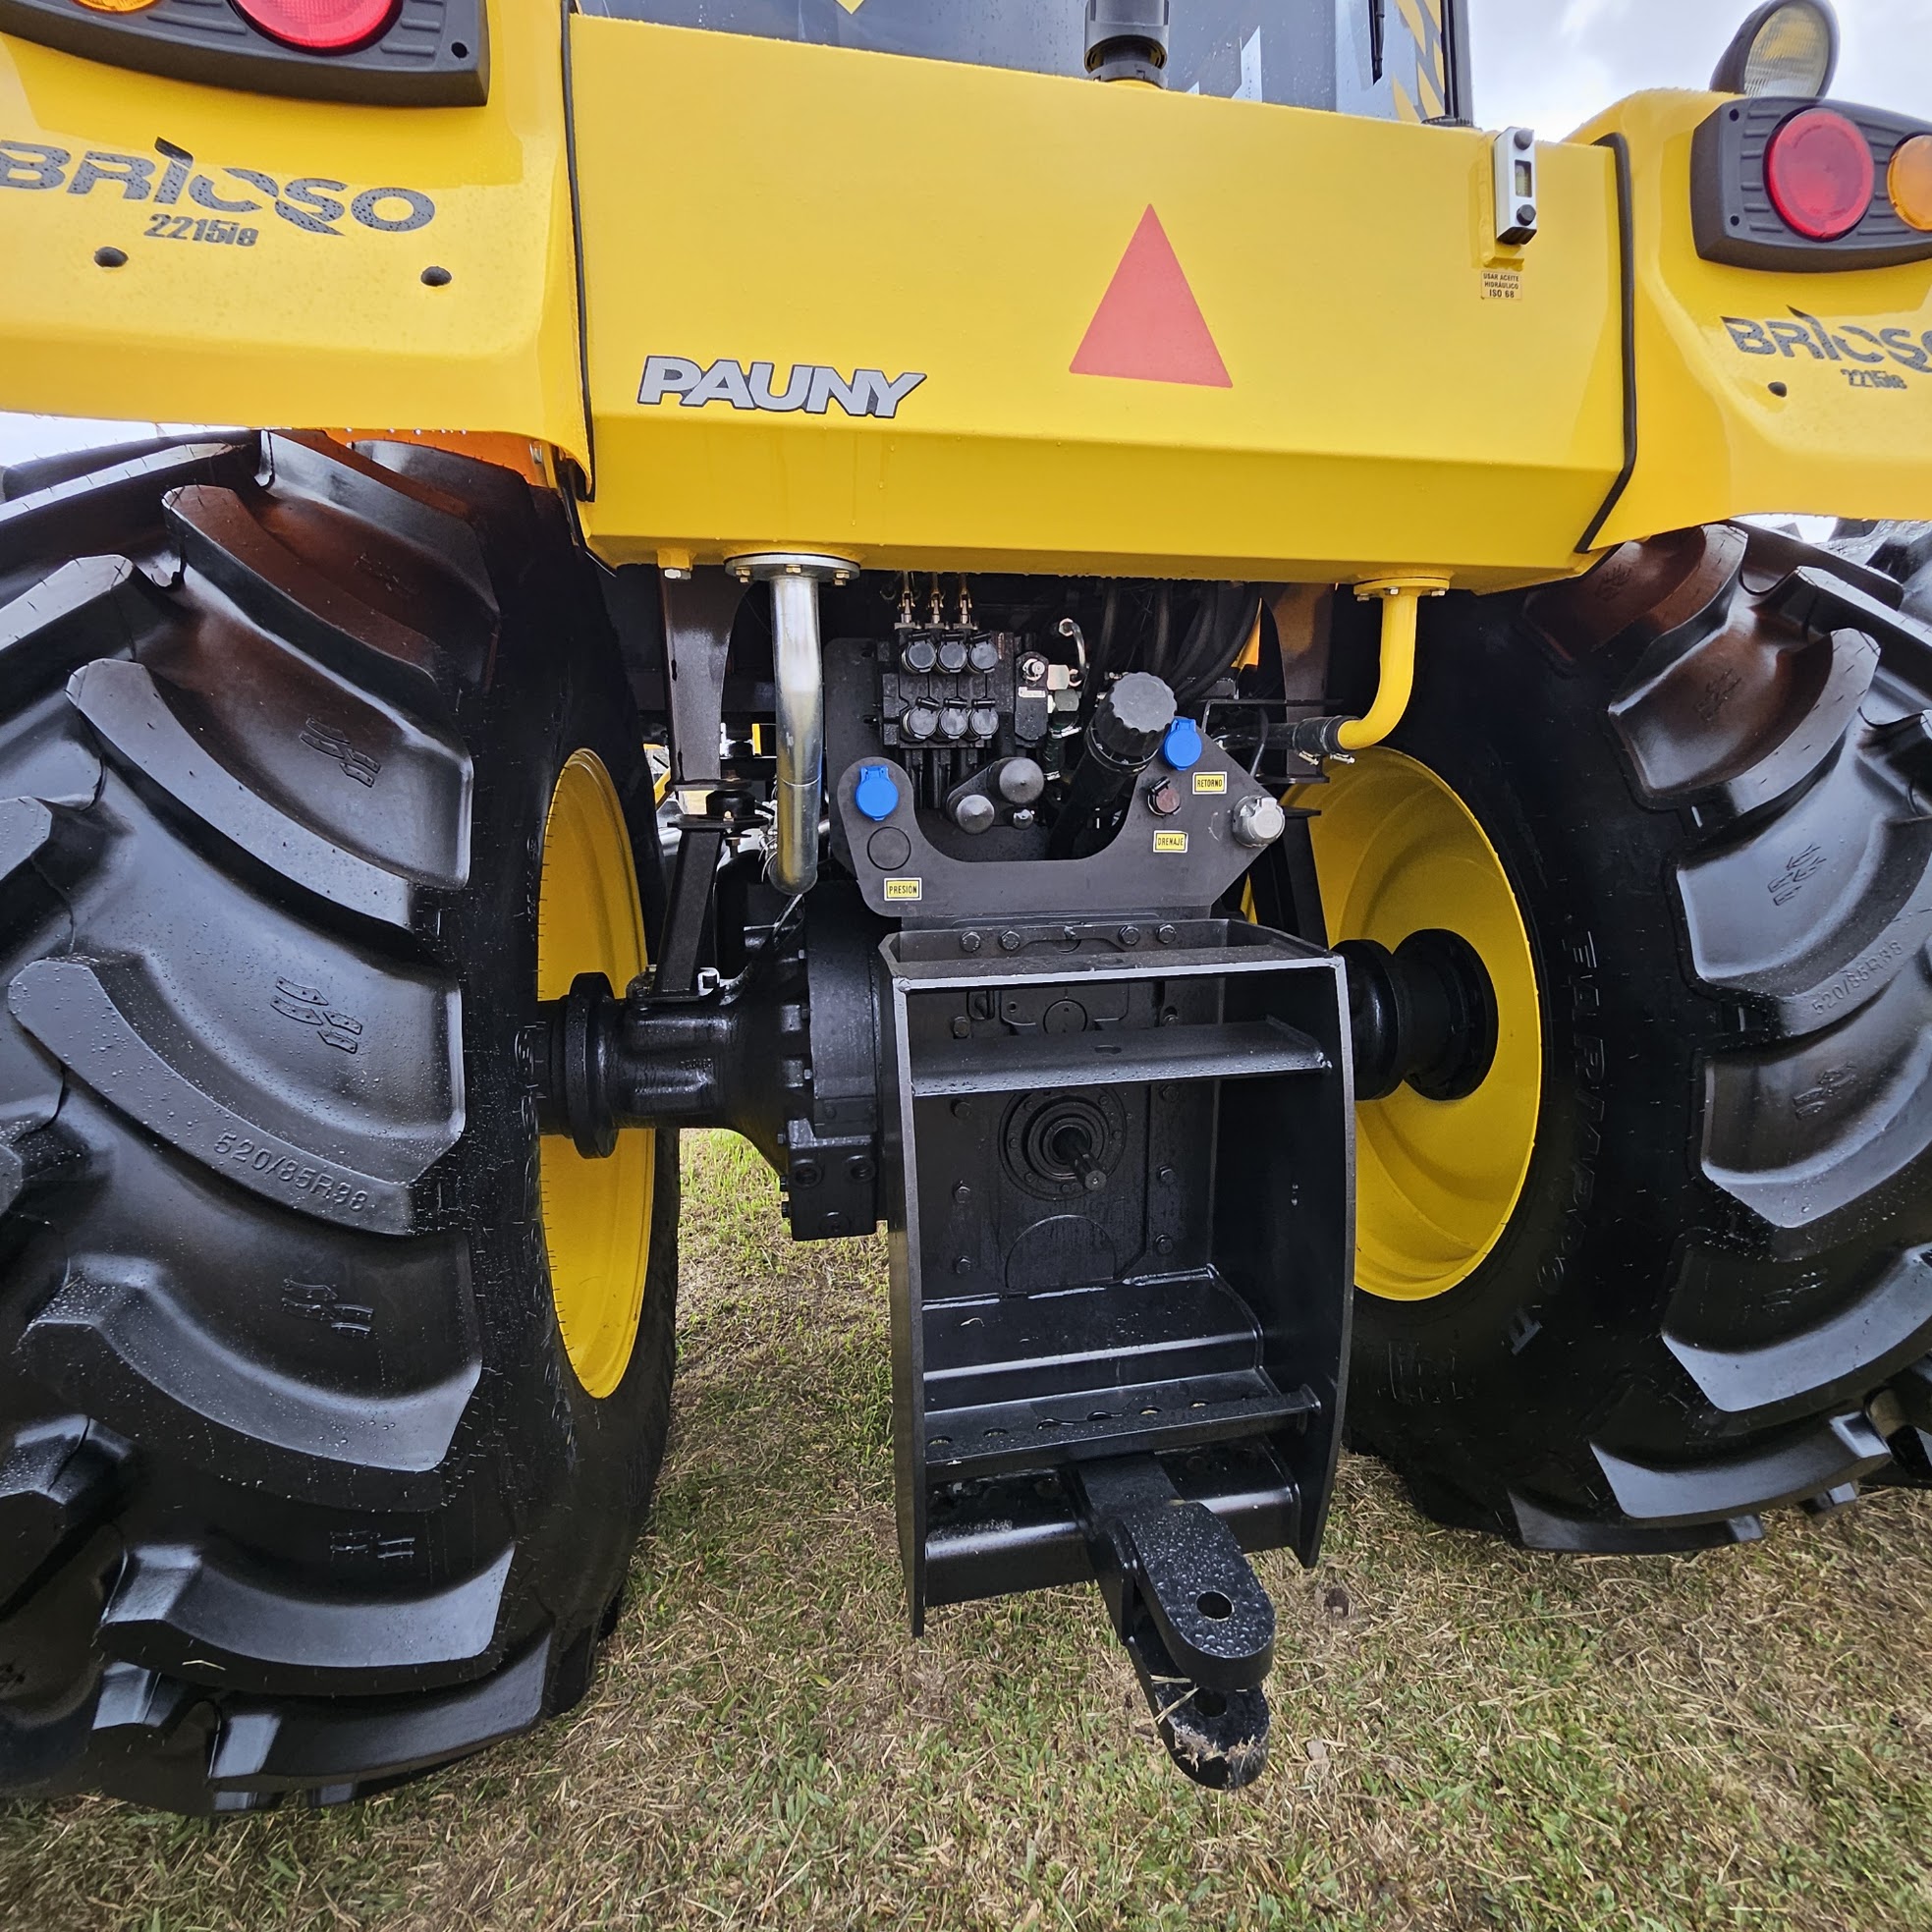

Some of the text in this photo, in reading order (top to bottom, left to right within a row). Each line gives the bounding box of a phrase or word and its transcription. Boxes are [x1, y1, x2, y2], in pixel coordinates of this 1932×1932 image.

[1489, 289, 1503, 298] ISO
[1720, 304, 1932, 373] BRIOS
[636, 355, 928, 418] PAUNY
[1196, 778, 1223, 788] RETORNO
[1157, 837, 1184, 847] DRENAJE
[889, 883, 917, 895] PRESIÓN
[213, 1131, 368, 1212] 520/85R38
